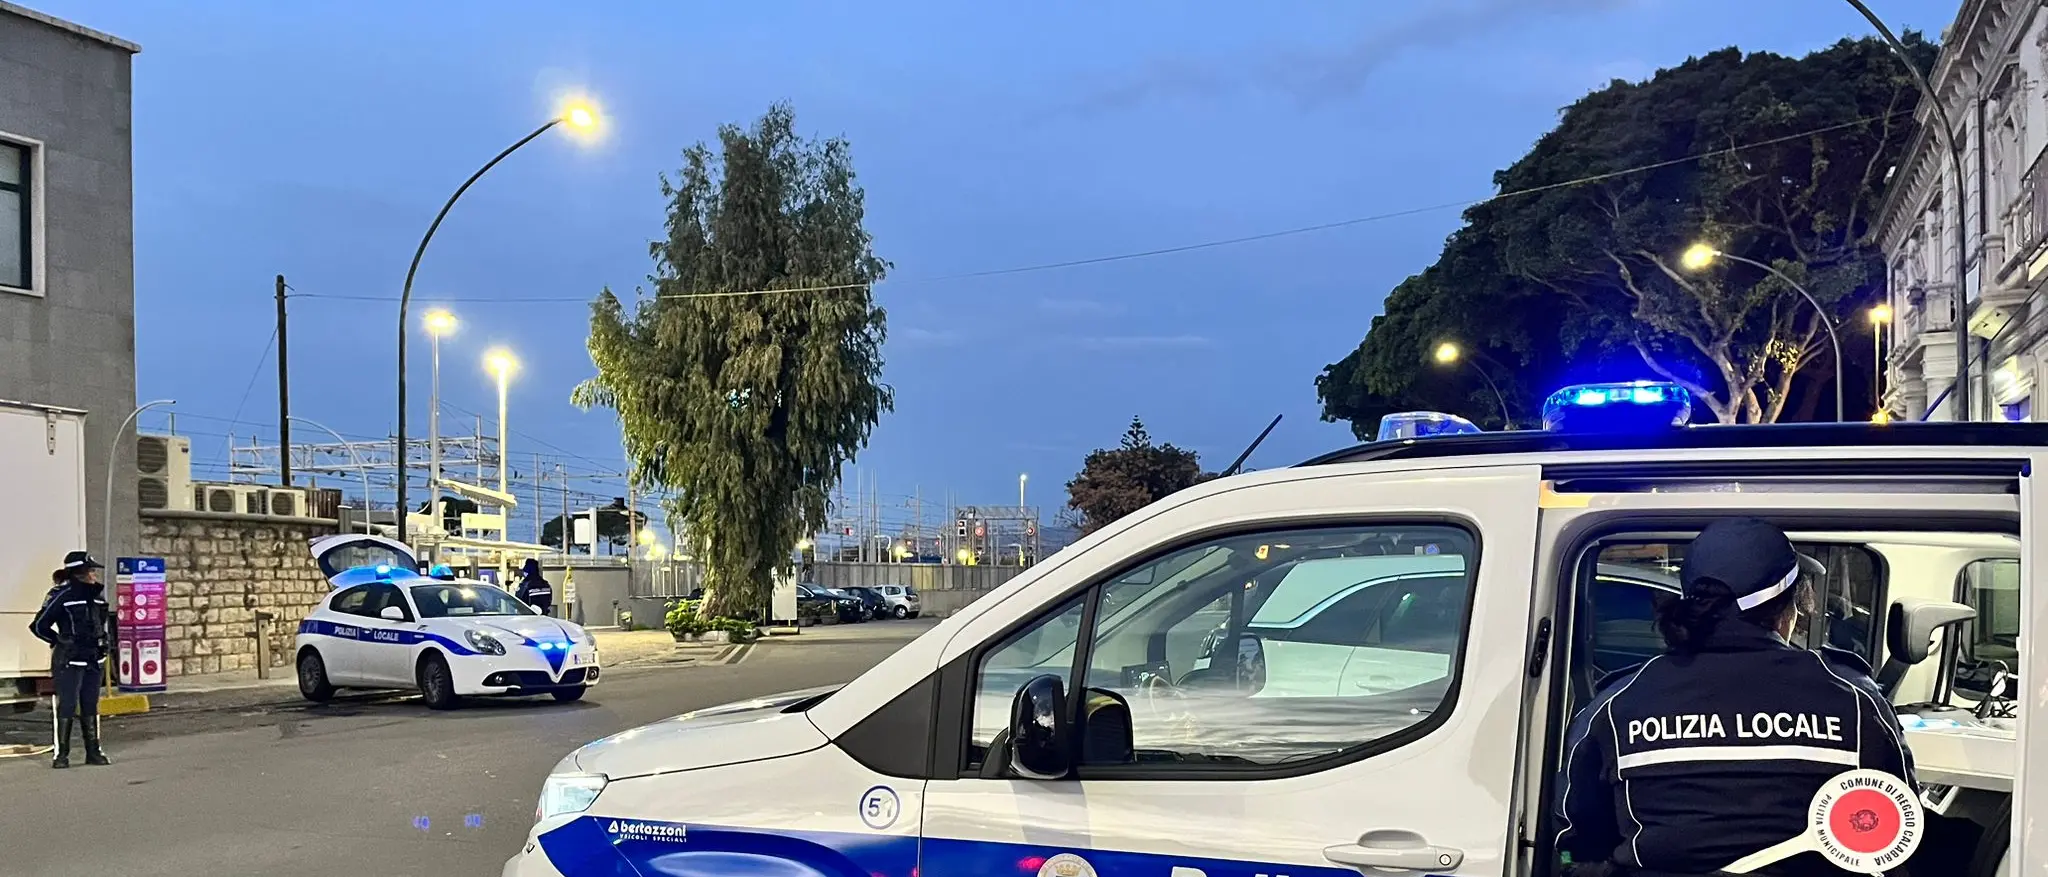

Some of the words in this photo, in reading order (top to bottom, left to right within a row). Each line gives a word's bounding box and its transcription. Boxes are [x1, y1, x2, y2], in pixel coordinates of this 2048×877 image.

[334, 626, 357, 637] POLIZIA
[373, 630, 399, 641] LOCALE
[1628, 713, 1726, 744] POLIZIA
[1736, 712, 1843, 741] LOCALE
[1840, 777, 1885, 791] COMUNE
[1885, 784, 1898, 796] DI
[868, 797, 892, 817] 51
[1816, 794, 1832, 825] POLIZIA
[1894, 793, 1916, 828] REGGIO
[620, 820, 687, 837] bertazzoni
[1817, 829, 1861, 867] MUNICIPALE
[1873, 830, 1914, 866] CALABRIA
